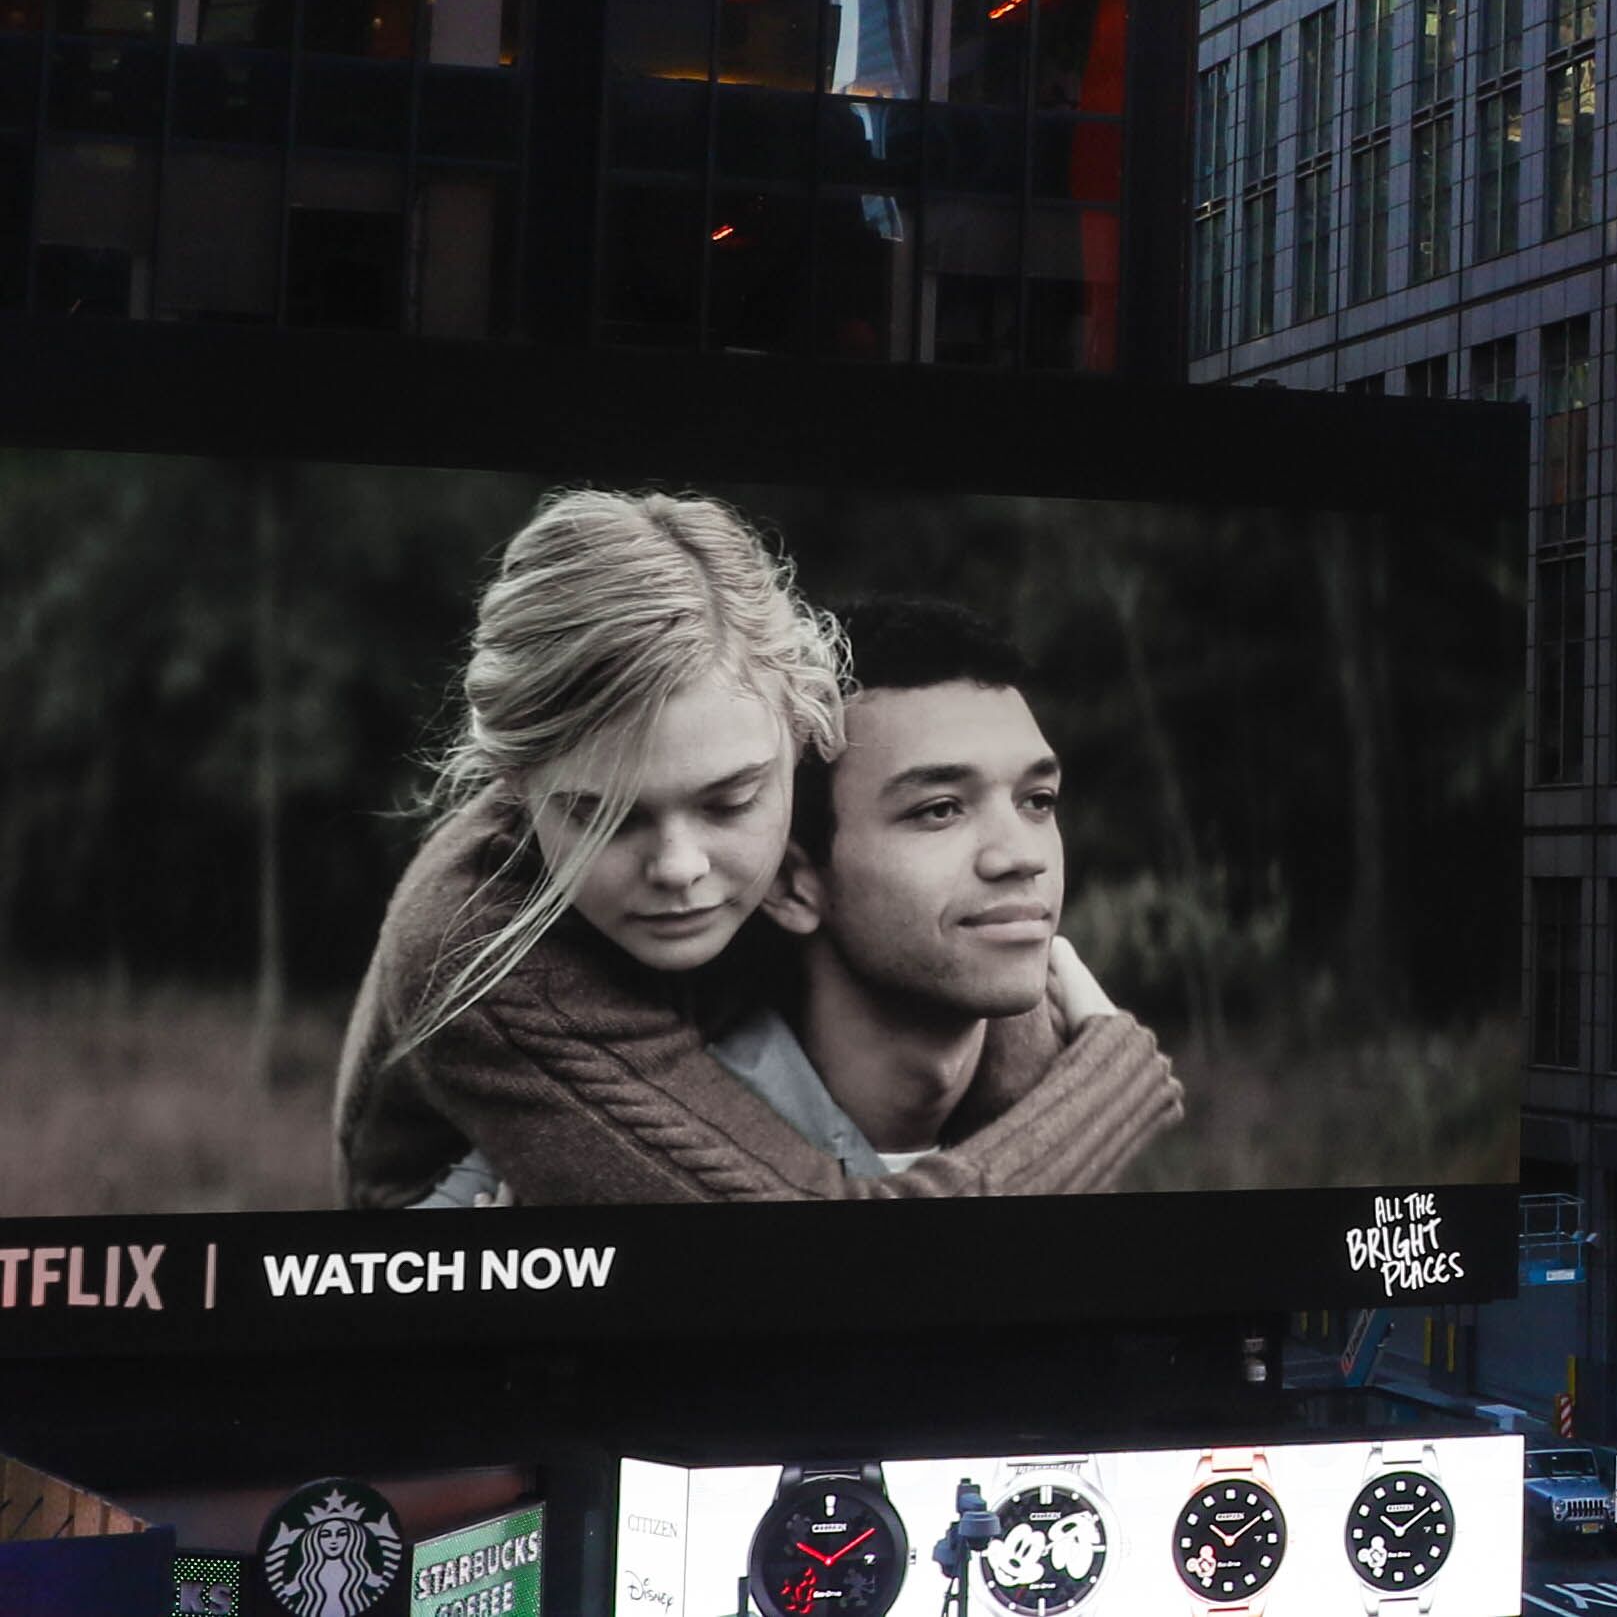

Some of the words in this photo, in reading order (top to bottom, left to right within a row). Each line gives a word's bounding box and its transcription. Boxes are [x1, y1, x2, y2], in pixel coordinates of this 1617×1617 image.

[1373, 1194, 1404, 1228] ALL
[1404, 1191, 1437, 1222] THE
[1346, 1217, 1443, 1272] BRIGHT
[0, 1244, 165, 1310] TFLIX
[263, 1250, 465, 1297] WATCH
[481, 1246, 616, 1290] NOW
[1380, 1251, 1466, 1298] PLACES
[627, 1514, 678, 1538] CITIZEN
[415, 1530, 543, 1601] STARBUCKS
[433, 1581, 515, 1617] COFFEE
